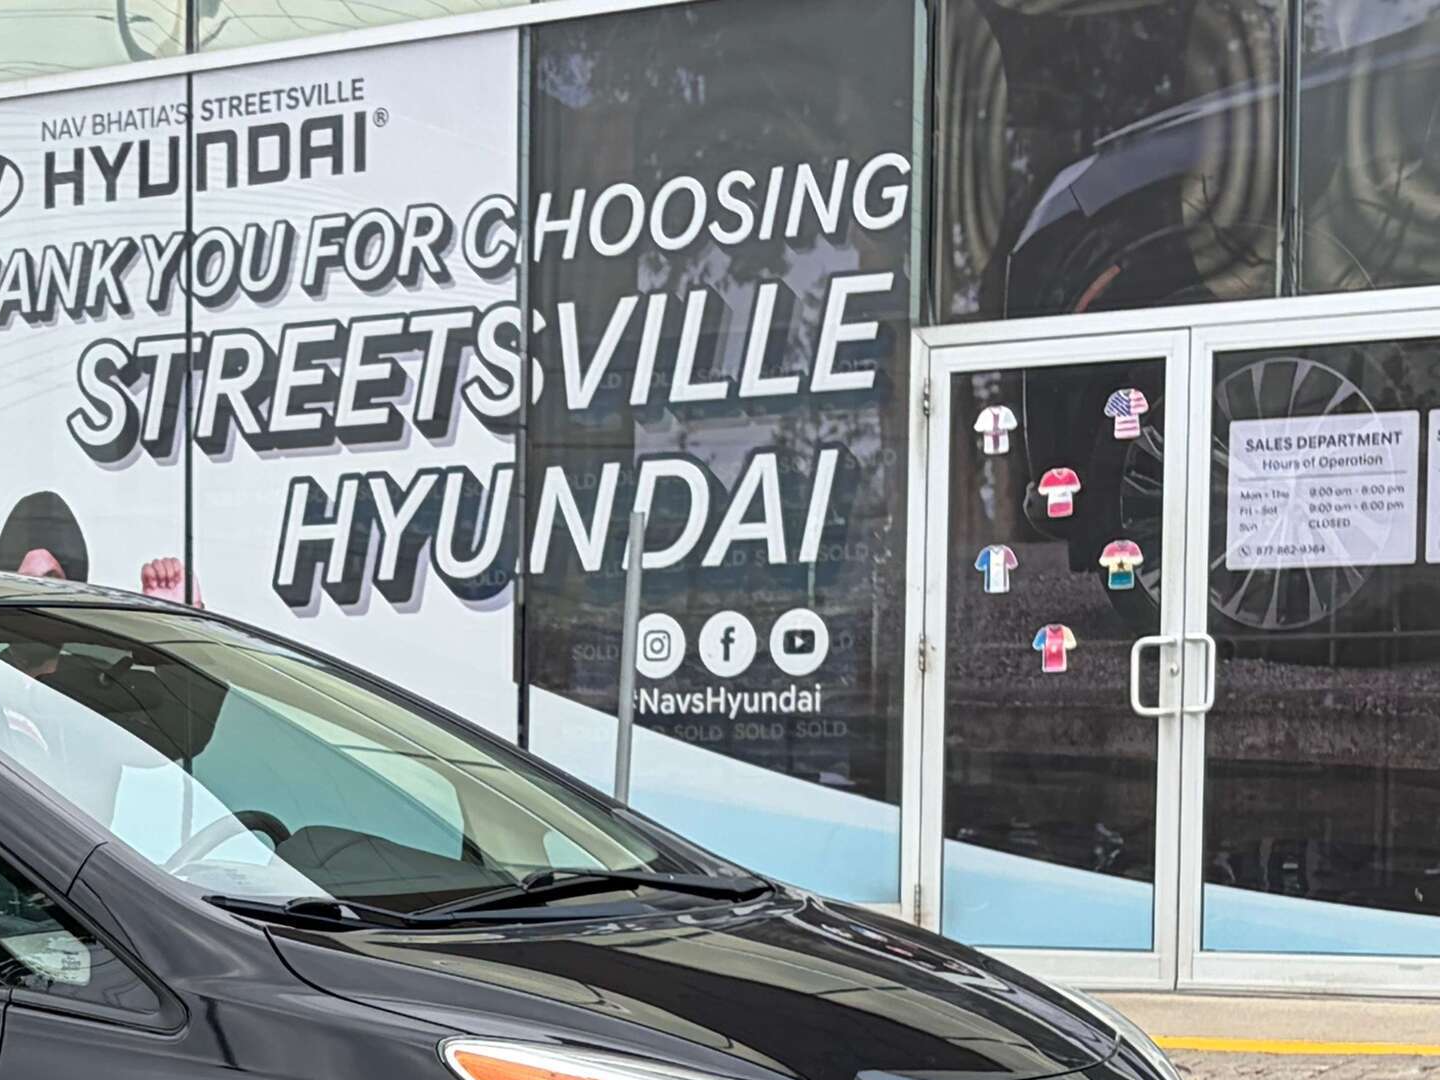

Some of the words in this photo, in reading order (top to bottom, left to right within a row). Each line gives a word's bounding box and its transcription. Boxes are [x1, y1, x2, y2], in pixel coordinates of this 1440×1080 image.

[41, 116, 85, 141] NAV
[92, 102, 189, 137] BHATIA'S
[200, 77, 364, 121] STREETSVILLE
[44, 111, 367, 209] HYUNDAI
[140, 219, 292, 302] YOU
[302, 203, 450, 296] FOR
[462, 151, 912, 282] CHOOSING
[66, 270, 894, 462] STREETSVILLE
[1245, 436, 1293, 452] SALES
[1296, 430, 1403, 450] DEPARTMENT
[1262, 458, 1300, 471] Hours
[1302, 456, 1316, 469] of
[1318, 454, 1383, 470] Operation
[274, 447, 840, 602] HYUNDAI
[1308, 518, 1351, 529] CLOSED
[571, 643, 620, 662] SOLD
[673, 724, 724, 742] SOLD
[734, 722, 784, 741] SOLD
[795, 719, 848, 739] SOLD
